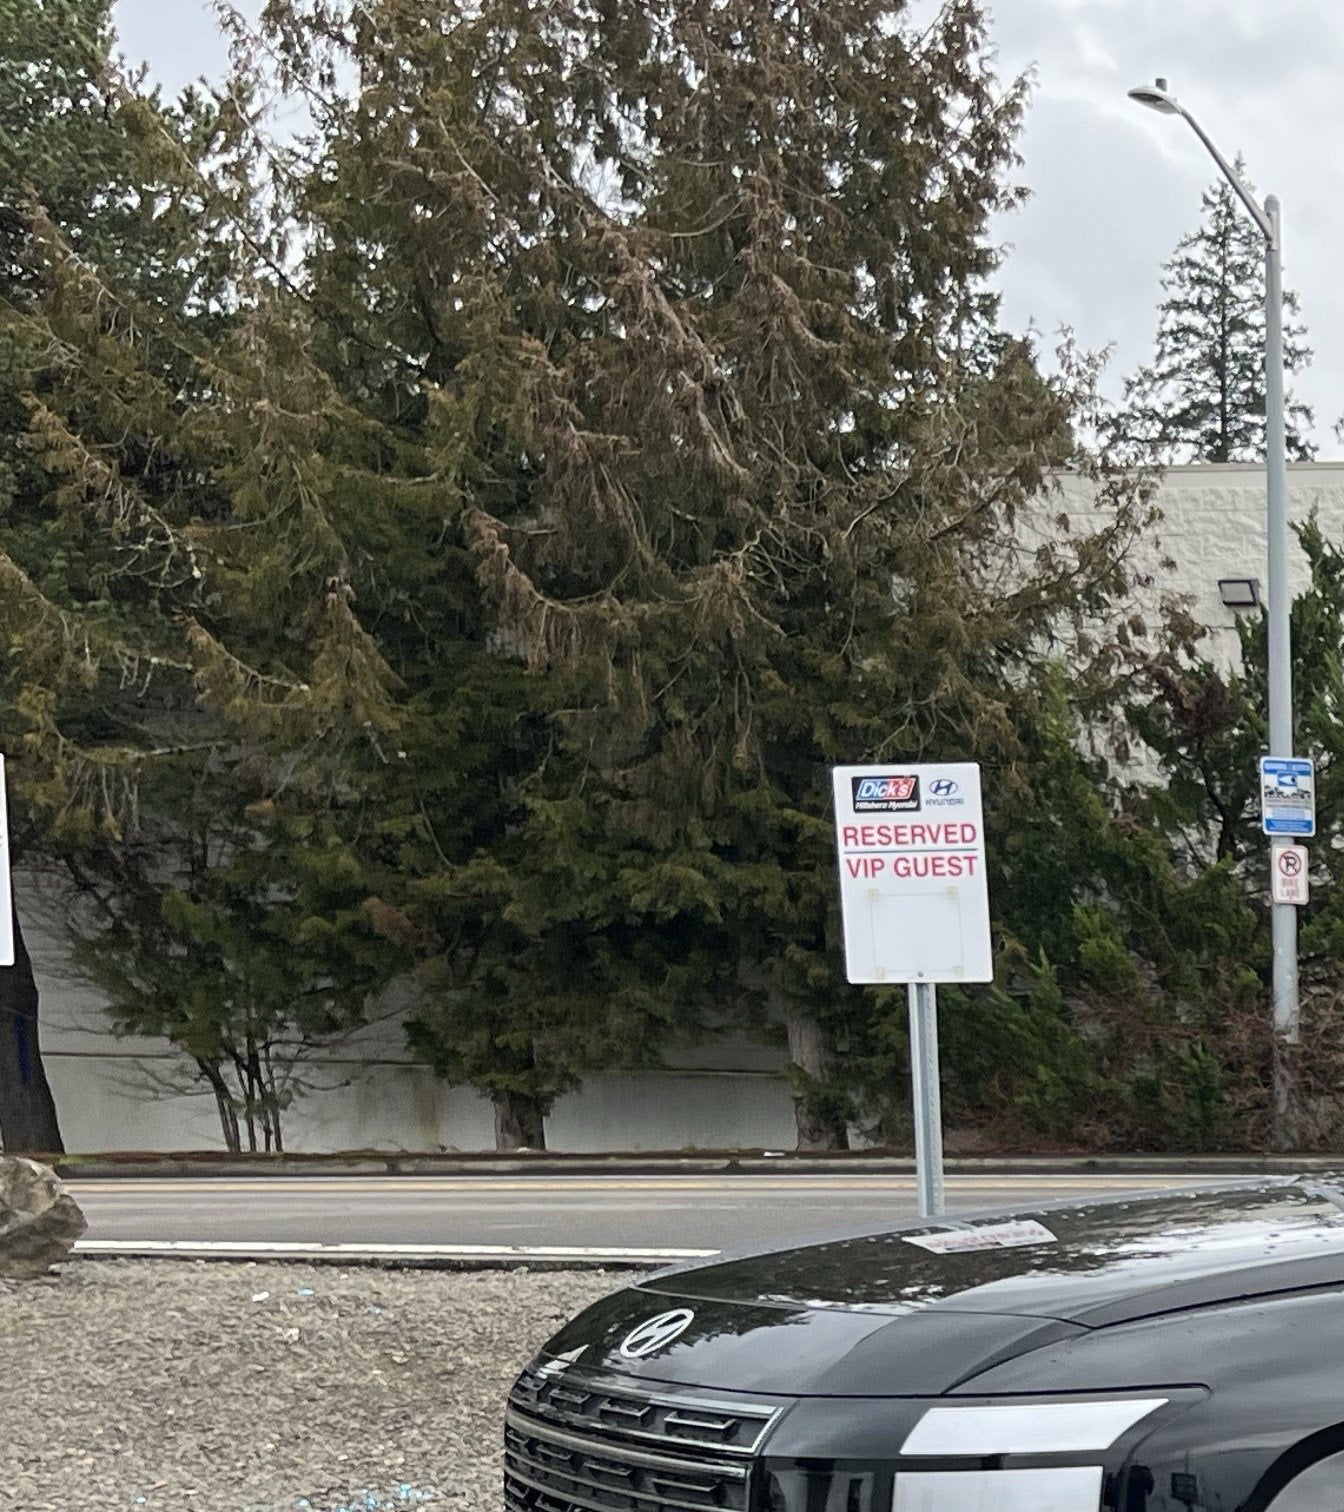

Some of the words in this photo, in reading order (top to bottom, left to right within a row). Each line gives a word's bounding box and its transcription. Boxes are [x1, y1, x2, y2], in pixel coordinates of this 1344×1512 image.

[842, 823, 977, 847] RESERVED
[846, 858, 885, 879] VIP
[893, 855, 978, 878] GUEST
